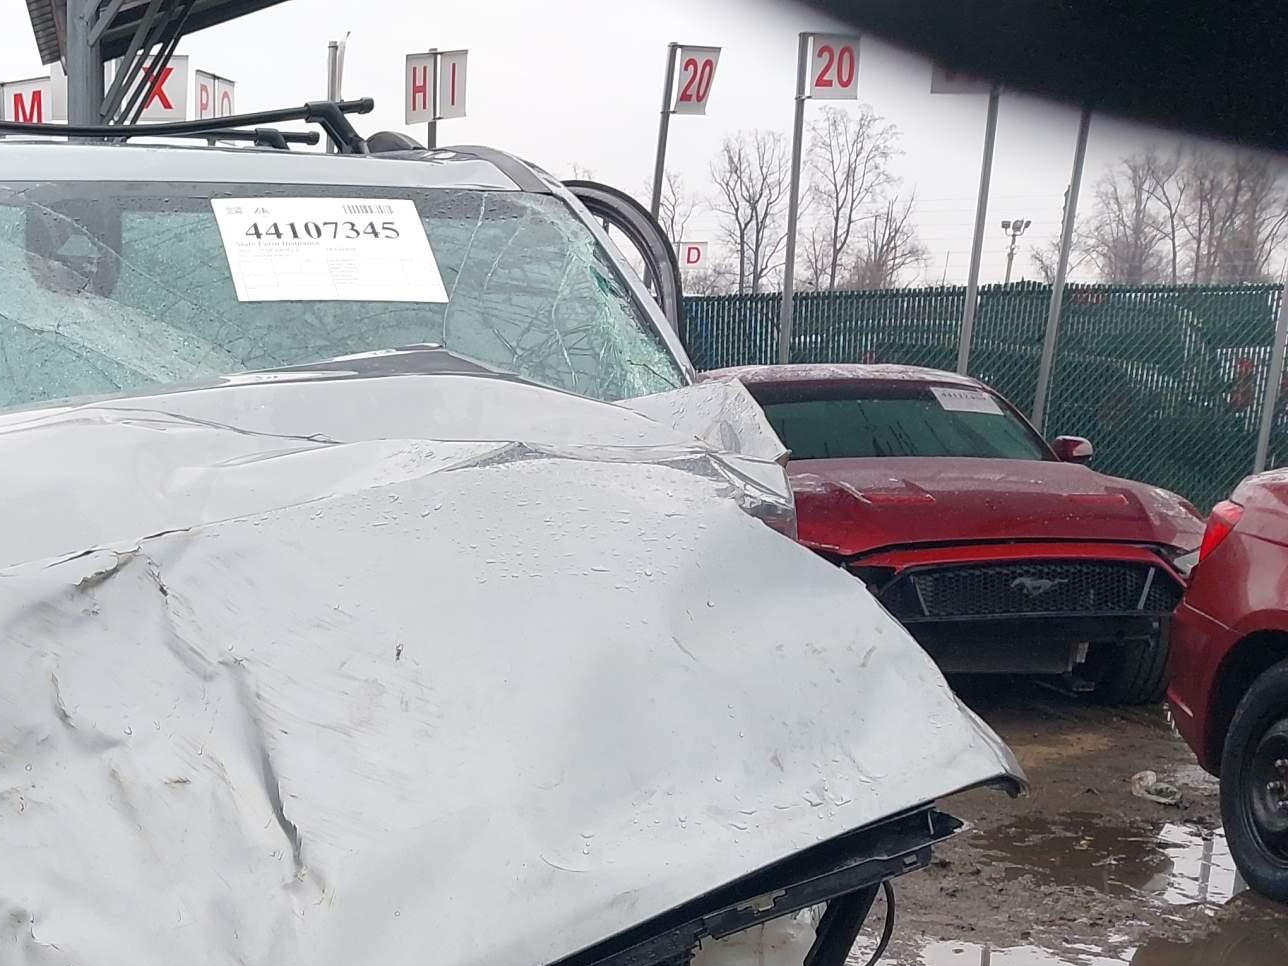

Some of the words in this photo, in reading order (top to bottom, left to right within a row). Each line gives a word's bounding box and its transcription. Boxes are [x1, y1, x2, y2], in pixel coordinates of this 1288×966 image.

[679, 58, 715, 103] 20
[814, 45, 856, 88] 20
[13, 90, 42, 124] M
[142, 67, 174, 110] X
[245, 221, 400, 240] 44107345
[686, 246, 701, 265] D
